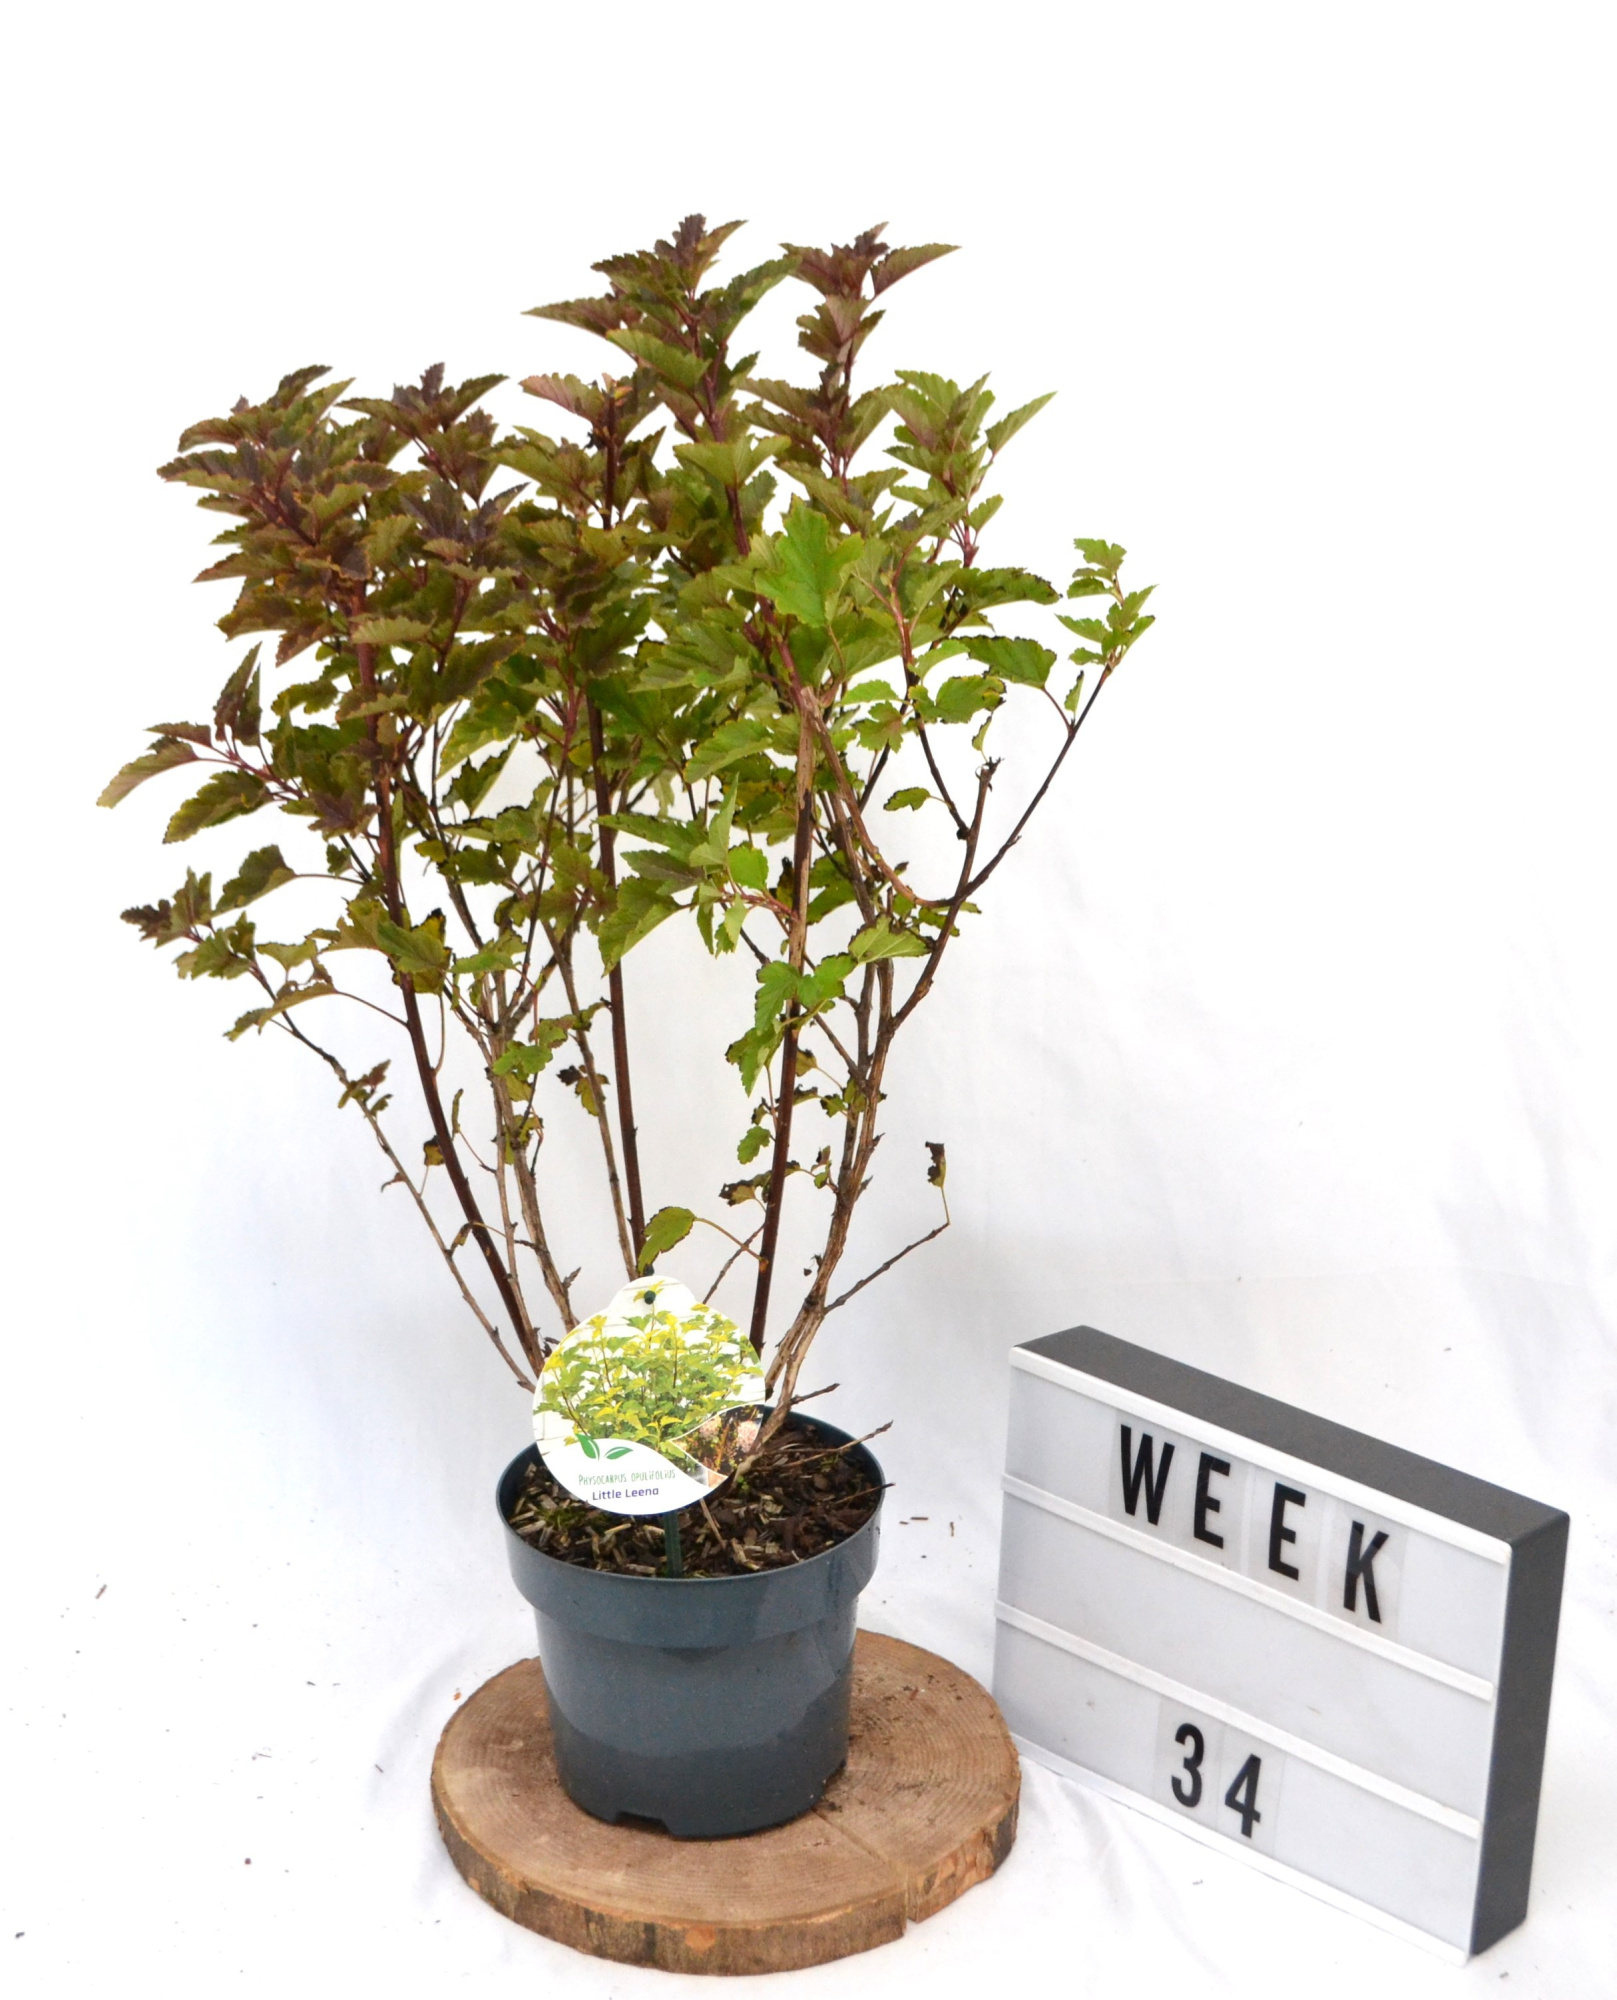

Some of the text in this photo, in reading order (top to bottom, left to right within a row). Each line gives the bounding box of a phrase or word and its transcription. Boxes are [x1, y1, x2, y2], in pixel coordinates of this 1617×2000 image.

[592, 1487, 659, 1500] Little Leena
[1120, 1424, 1389, 1624] WEEK
[1171, 1723, 1262, 1838] 34
